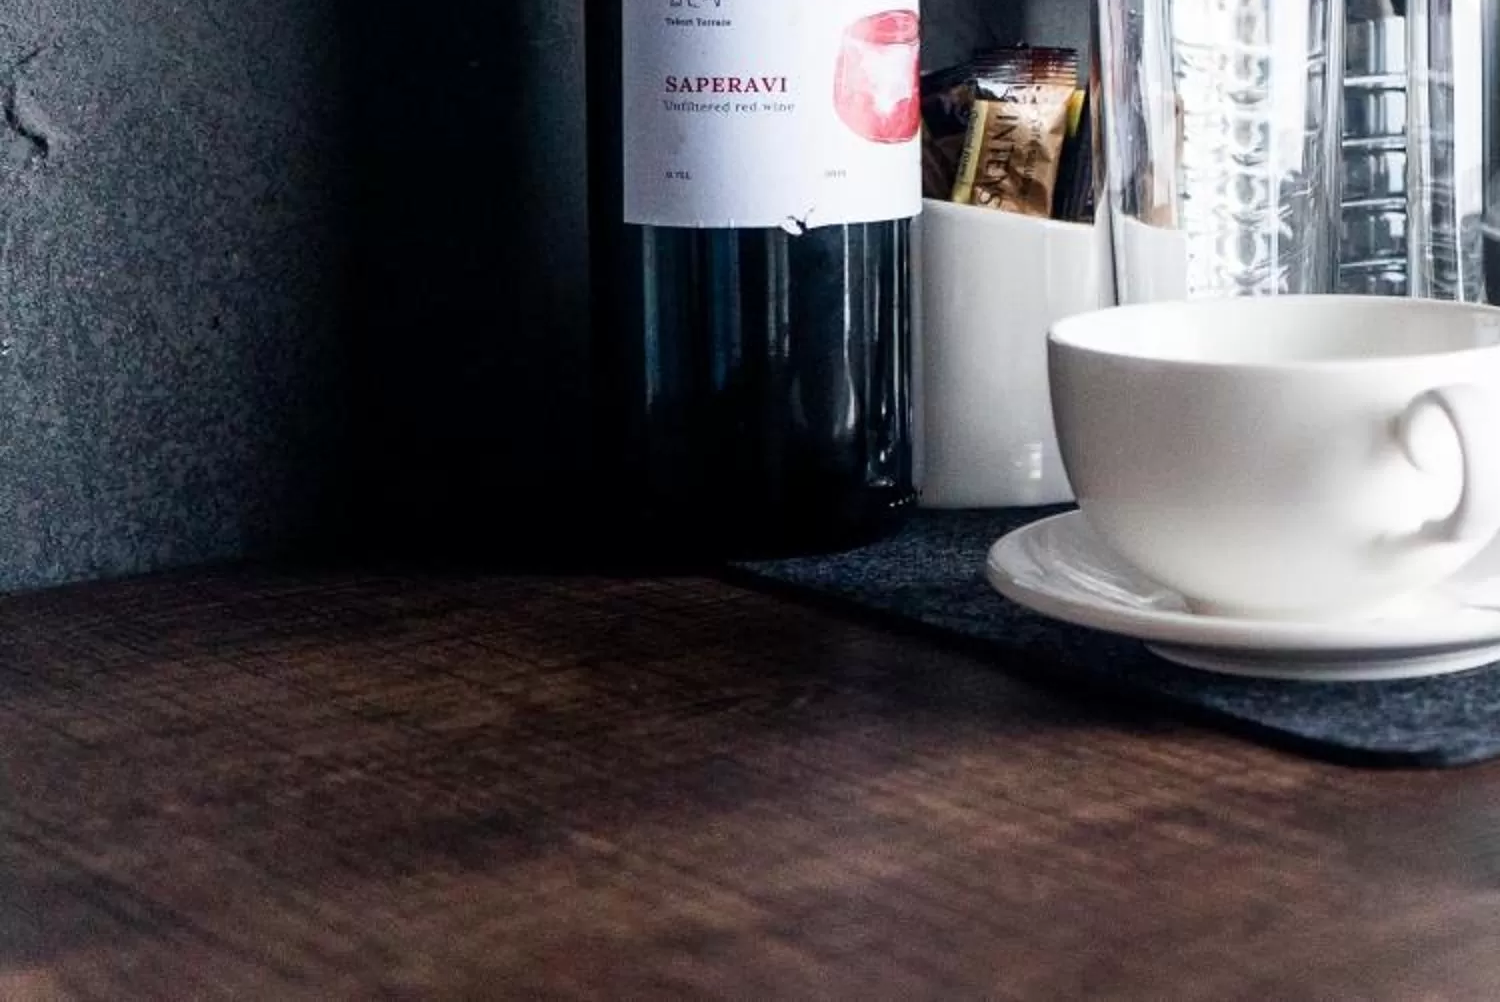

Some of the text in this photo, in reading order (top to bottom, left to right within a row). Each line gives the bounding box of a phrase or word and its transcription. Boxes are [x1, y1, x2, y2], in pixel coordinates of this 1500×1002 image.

[664, 75, 788, 93] SAPERAVI
[663, 100, 795, 113] Unfiltered red wine
